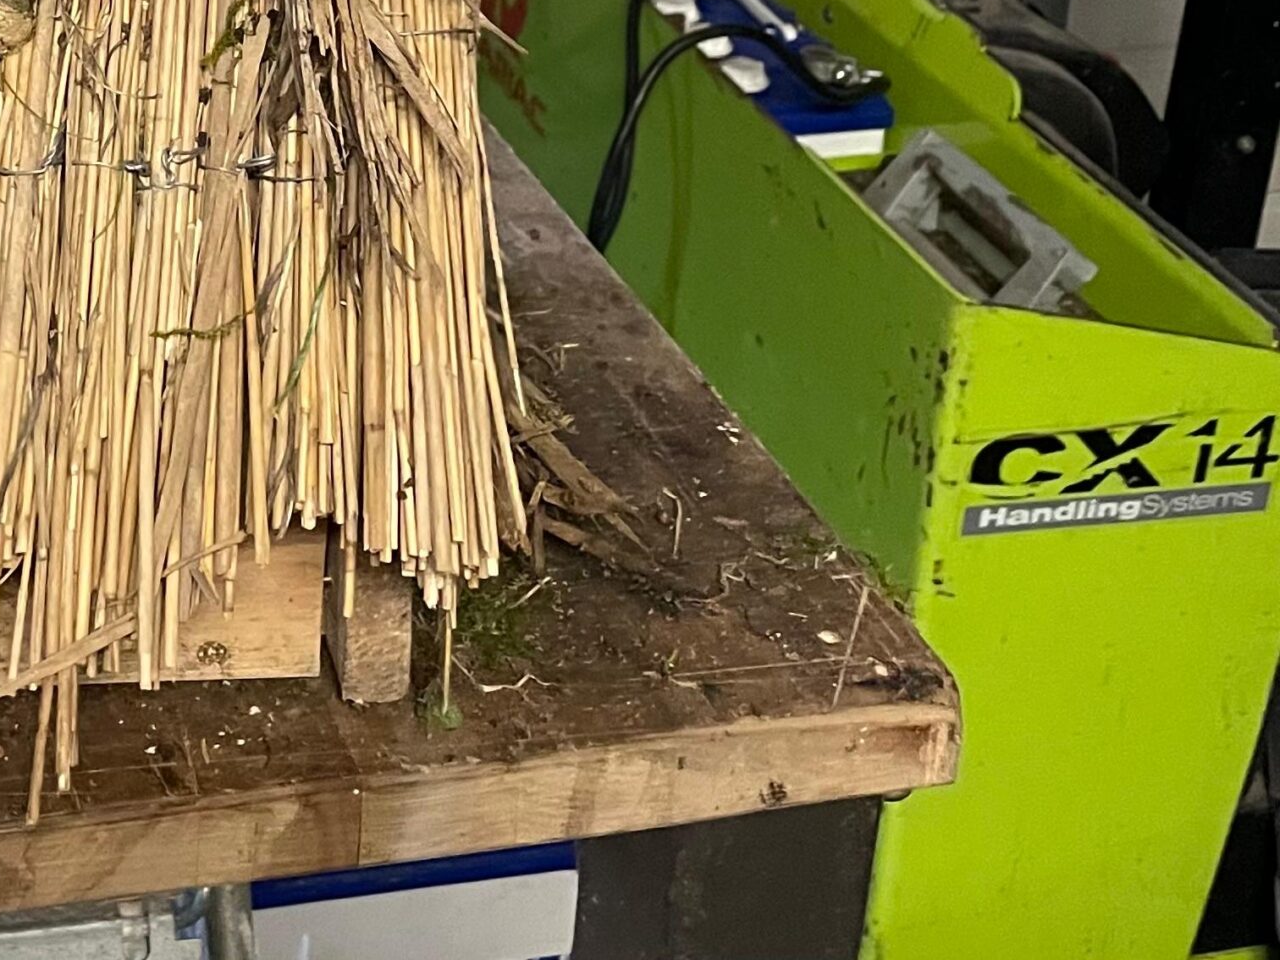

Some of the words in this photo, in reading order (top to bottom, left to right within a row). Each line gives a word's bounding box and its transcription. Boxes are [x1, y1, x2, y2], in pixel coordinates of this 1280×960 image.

[968, 423, 1176, 498] CX
[1185, 415, 1279, 483] 14
[977, 490, 1255, 529] HandlingSystems
